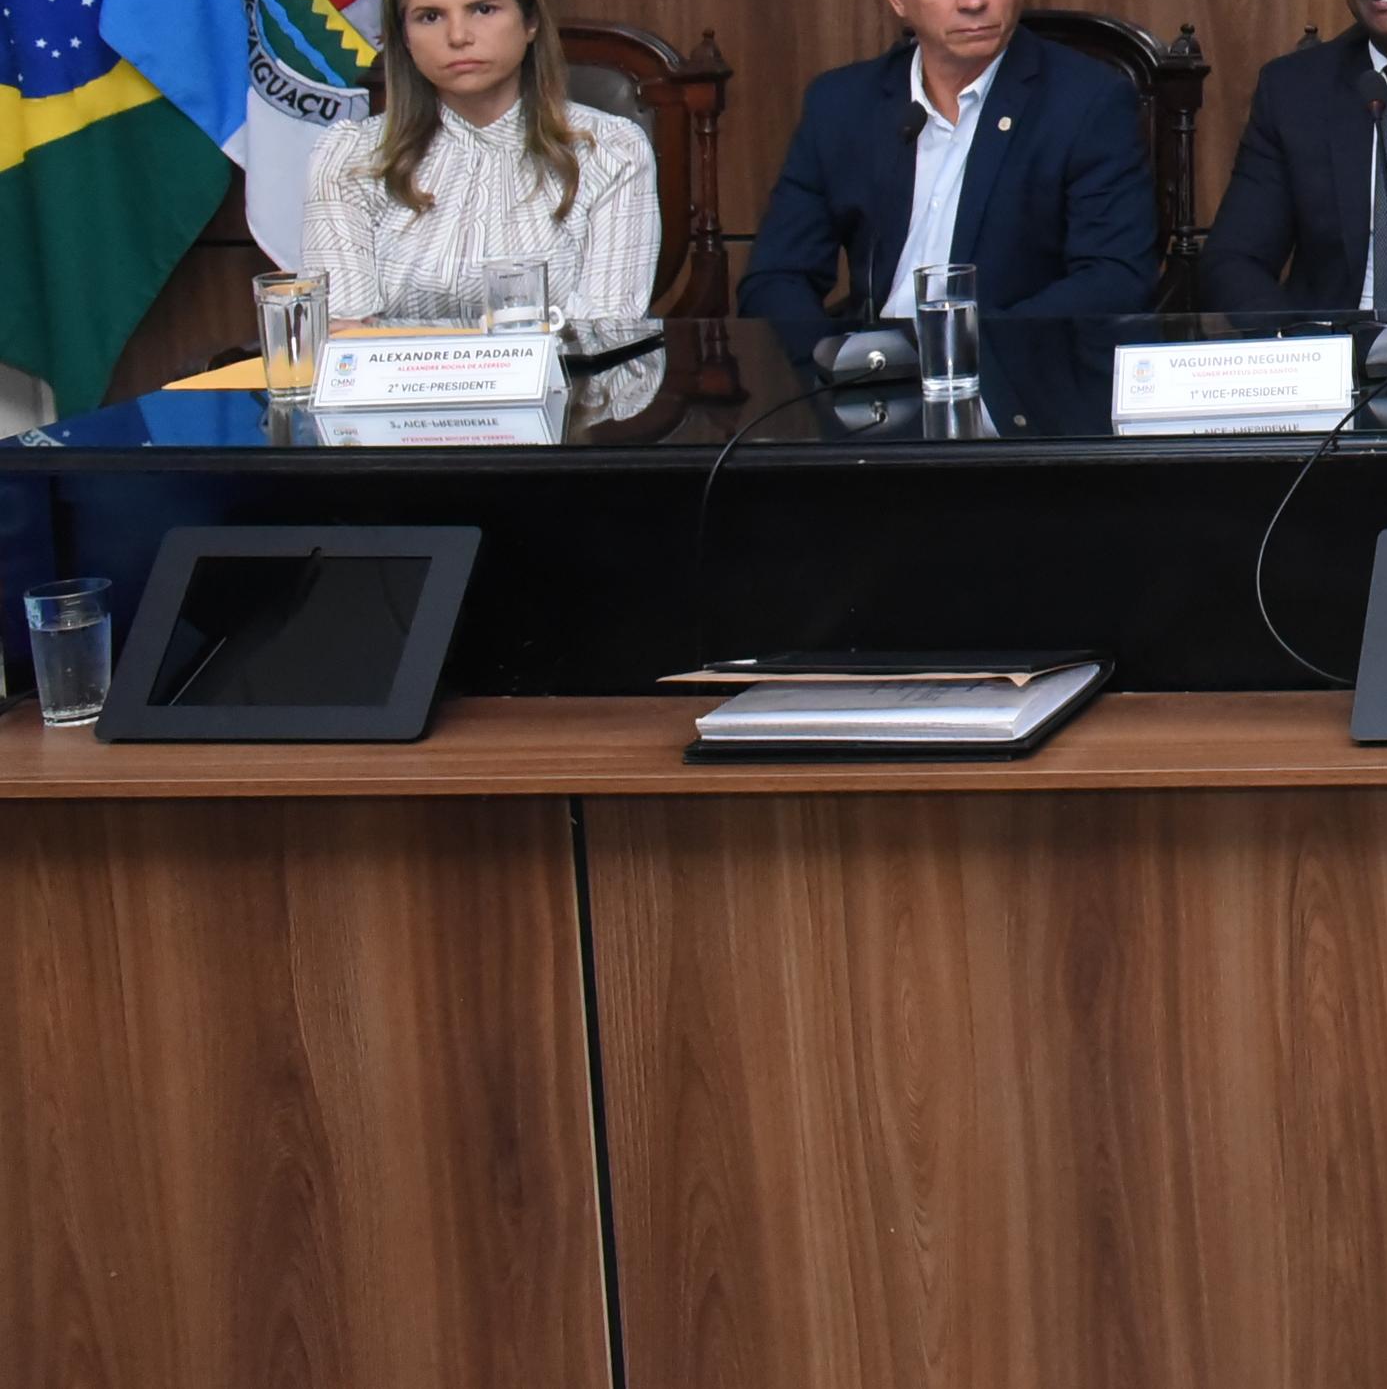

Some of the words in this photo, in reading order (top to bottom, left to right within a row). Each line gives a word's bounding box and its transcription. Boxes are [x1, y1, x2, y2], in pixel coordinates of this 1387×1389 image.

[249, 53, 341, 121] IGUAÇU
[369, 350, 449, 363] ALEXANDRE
[453, 349, 471, 360] DA
[475, 347, 534, 359] PADARIA
[1169, 355, 1244, 369] VAGUINHO
[1247, 351, 1321, 365] NEGUINHO
[401, 380, 497, 393] VICE-PRESIDENTE
[1202, 385, 1298, 399] VICE-PRESIDENTE
